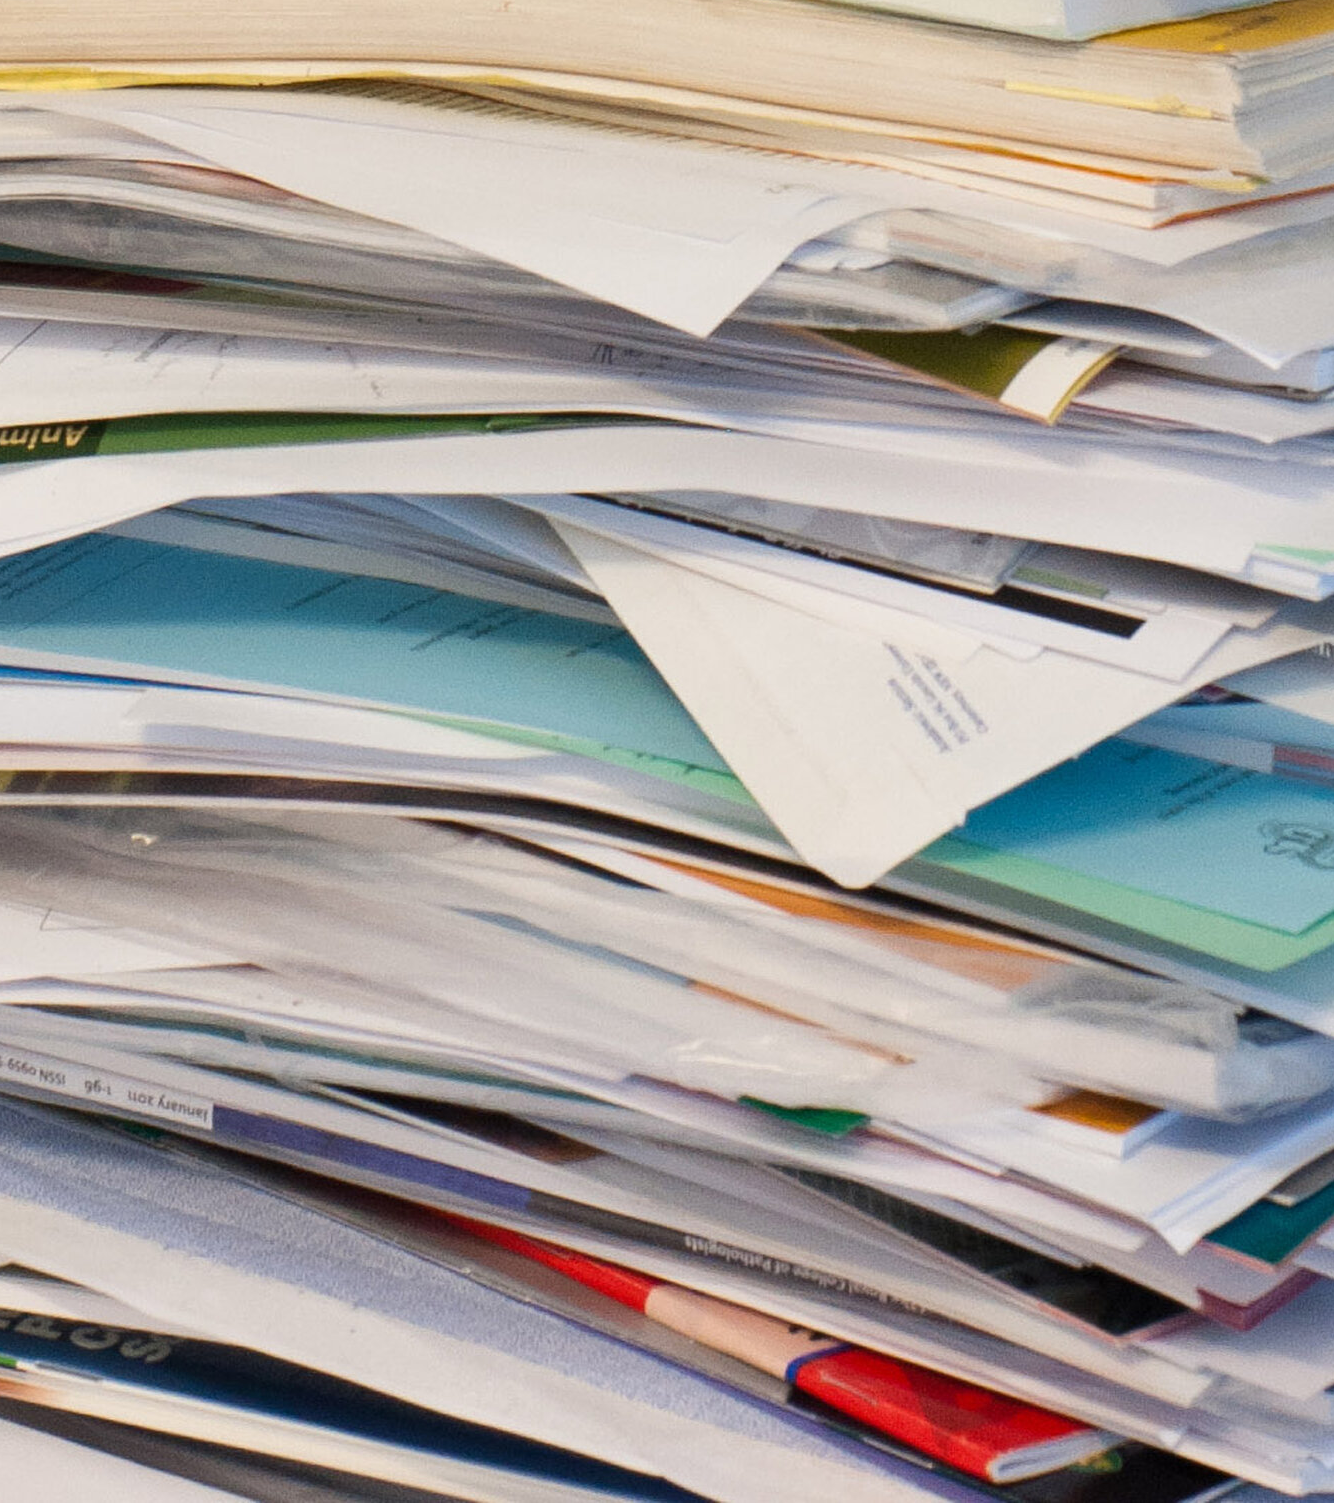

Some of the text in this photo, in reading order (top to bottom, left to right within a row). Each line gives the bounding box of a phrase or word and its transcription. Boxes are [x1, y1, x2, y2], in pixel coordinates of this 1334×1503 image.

[7, 1059, 37, 1077] 0959
[39, 1069, 67, 1086] ISSN
[83, 1079, 112, 1095] 1-96
[128, 1089, 154, 1105] 2011
[157, 1094, 209, 1122] January
[684, 1235, 773, 1272] Pathologists
